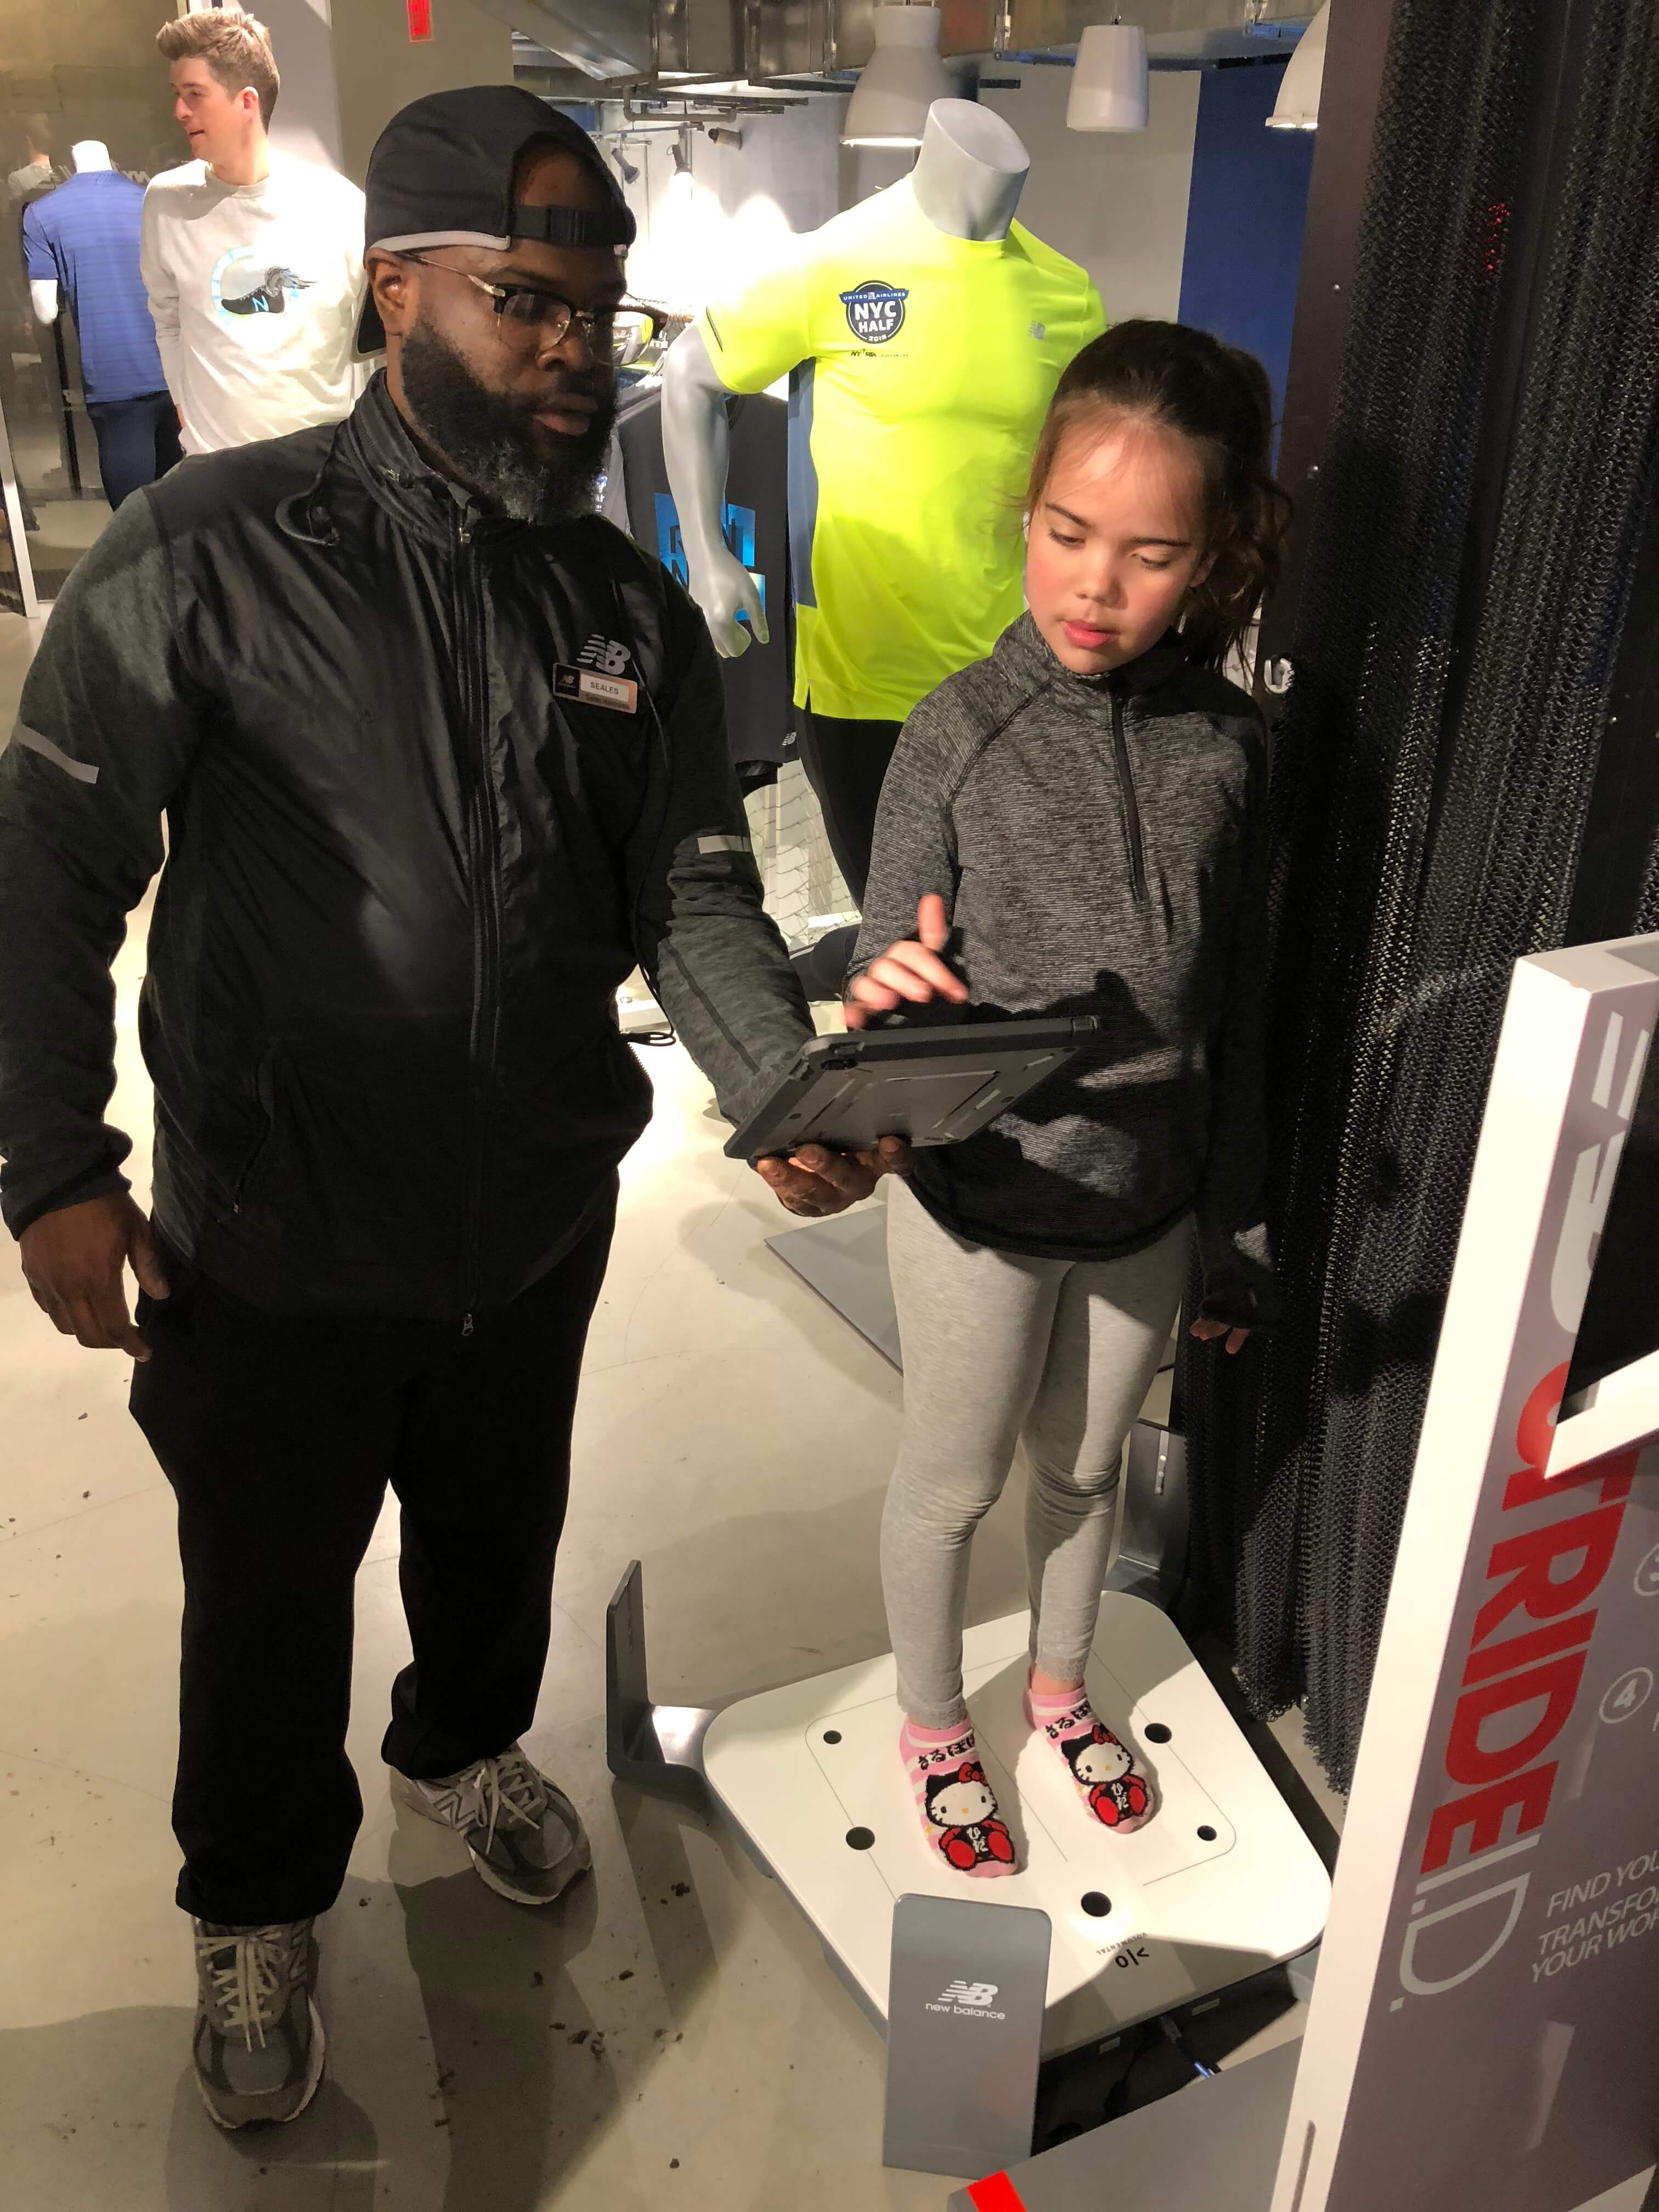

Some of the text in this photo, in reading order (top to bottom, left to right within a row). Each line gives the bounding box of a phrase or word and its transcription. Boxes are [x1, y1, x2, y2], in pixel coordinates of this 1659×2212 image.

[854, 301, 896, 320] NYC
[858, 319, 894, 333] HALF
[590, 682, 619, 695] SEALES
[1613, 1678, 1638, 1708] 4
[1547, 1872, 1611, 1918] FIND
[1539, 1886, 1659, 1955] TRANSFO
[1531, 1934, 1602, 1982] YOUR
[926, 2003, 1005, 2019] new balance
